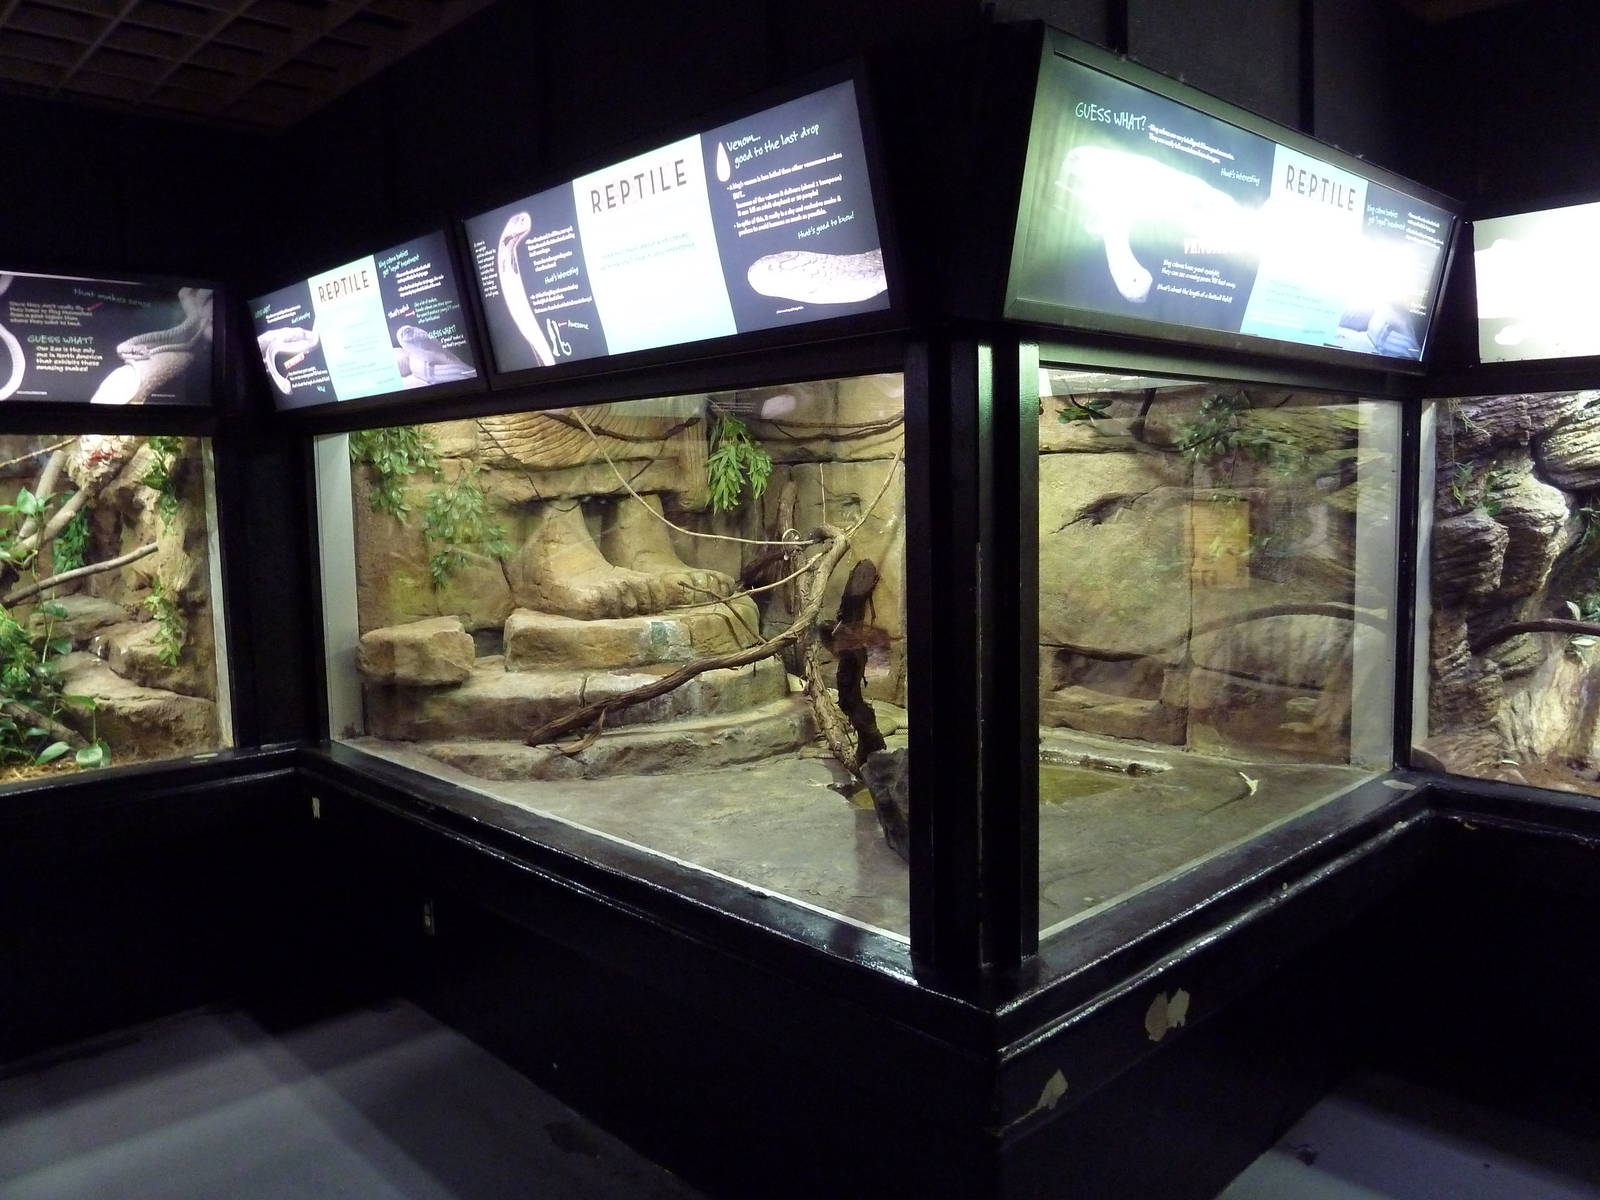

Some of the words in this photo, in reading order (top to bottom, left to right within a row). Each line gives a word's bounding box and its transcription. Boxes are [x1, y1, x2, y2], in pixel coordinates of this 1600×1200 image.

[1075, 102, 1111, 122] GUESS
[1114, 112, 1147, 131] WHAT?
[735, 151, 753, 168] good
[754, 148, 763, 157] to
[765, 141, 780, 152] the
[782, 131, 798, 145] last
[801, 124, 819, 138] drop
[590, 159, 687, 214] REPTILE
[1286, 165, 1356, 212] REPTILE
[318, 270, 371, 302] REPTILE
[27, 334, 61, 343] GUESS
